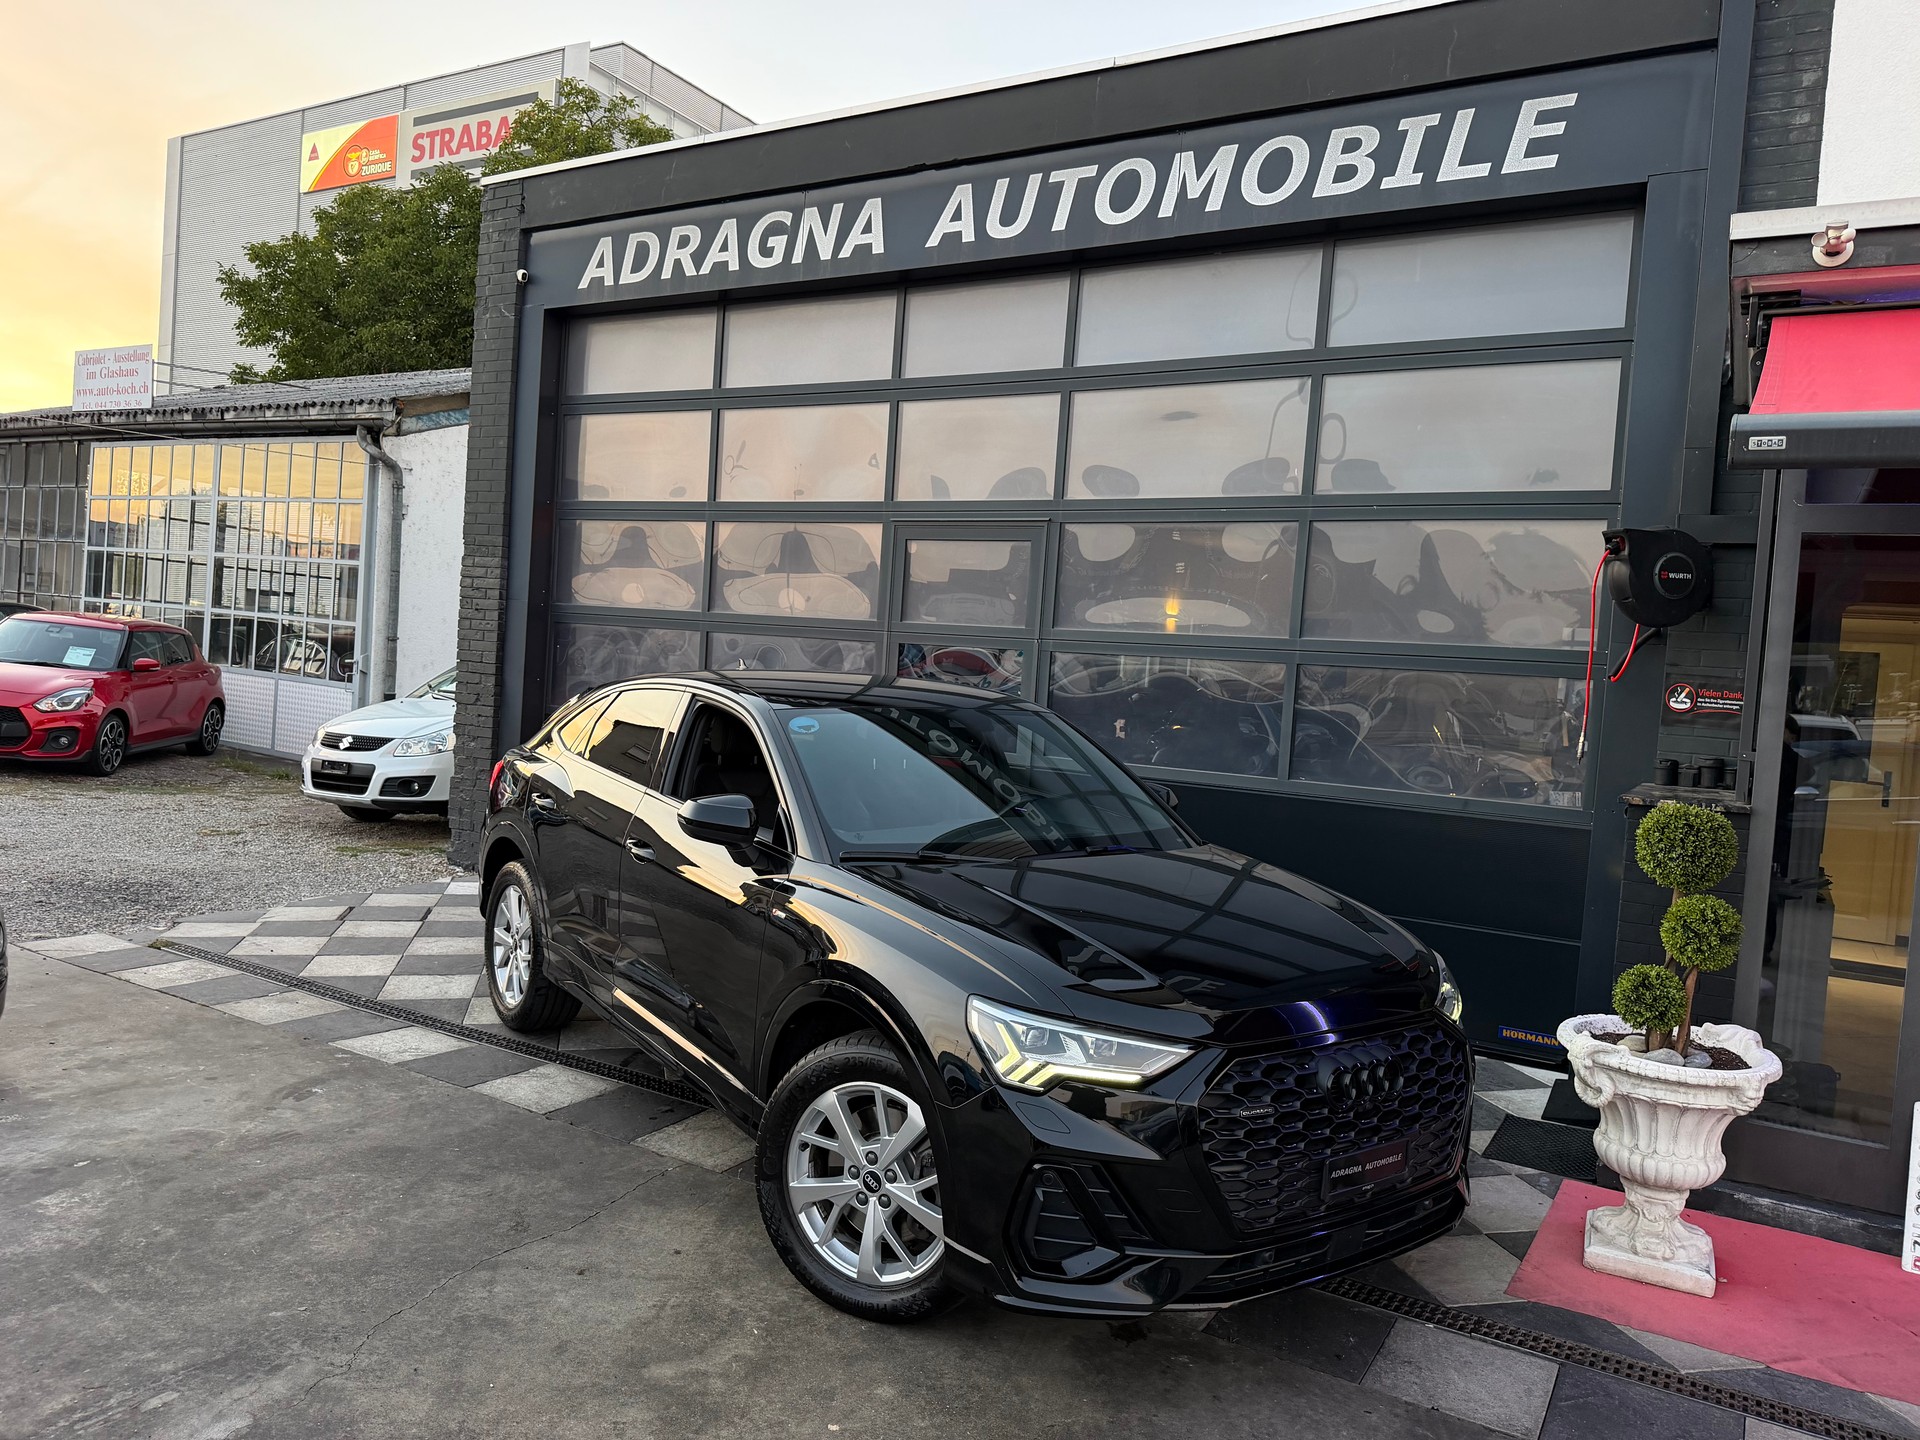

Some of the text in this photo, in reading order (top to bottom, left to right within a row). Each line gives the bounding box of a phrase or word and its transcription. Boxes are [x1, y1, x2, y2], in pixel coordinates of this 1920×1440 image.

[410, 115, 514, 163] STRABA
[361, 161, 392, 176] ZURIQUE
[578, 92, 1580, 289] ADRAGNA AUTOMOBILE
[77, 352, 106, 366] Cabriolet
[113, 349, 150, 364] Ausstellung
[86, 366, 139, 380] im Glashaus
[76, 381, 149, 397] www.auto-koch.ch
[95, 401, 107, 409] 044
[1698, 688, 1722, 697] Vielen
[1330, 1153, 1402, 1178] ADRAGNA AUTOMOBILE
